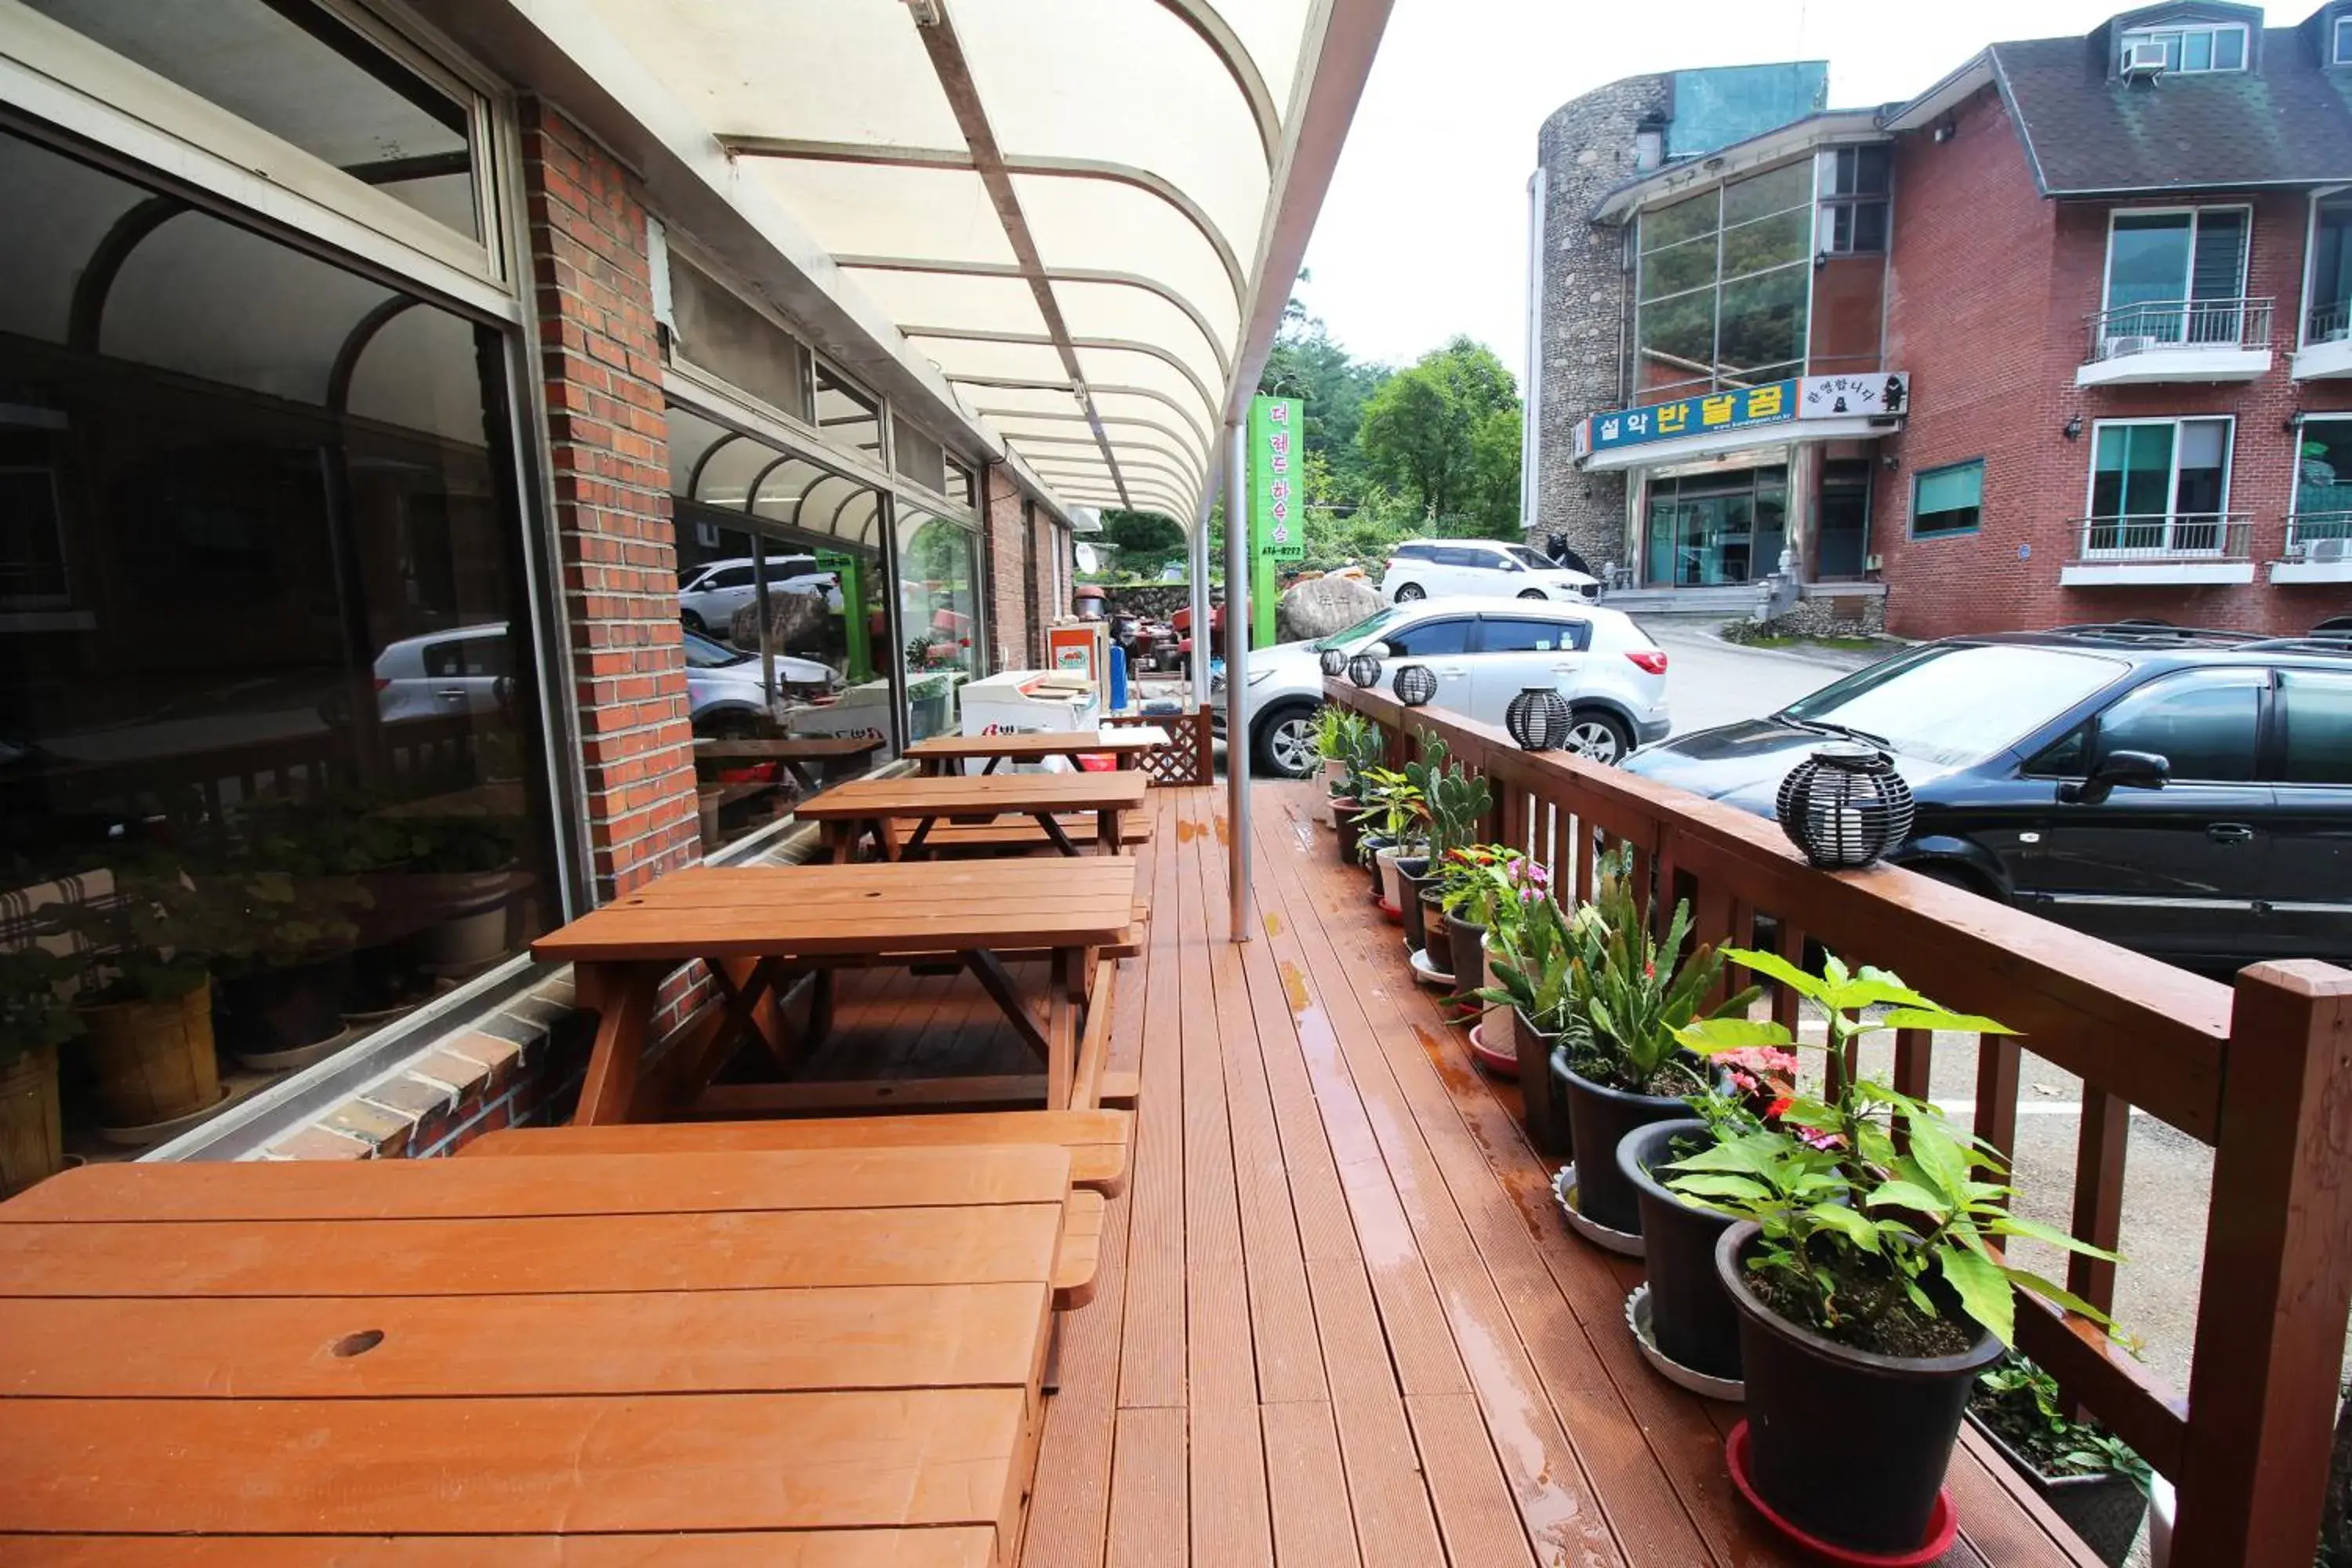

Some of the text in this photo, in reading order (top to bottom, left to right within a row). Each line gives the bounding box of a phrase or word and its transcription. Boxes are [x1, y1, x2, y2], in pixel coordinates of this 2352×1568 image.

[1807, 378, 1875, 404] 환영합니다
[1600, 386, 1782, 441] 설악 반달곰
